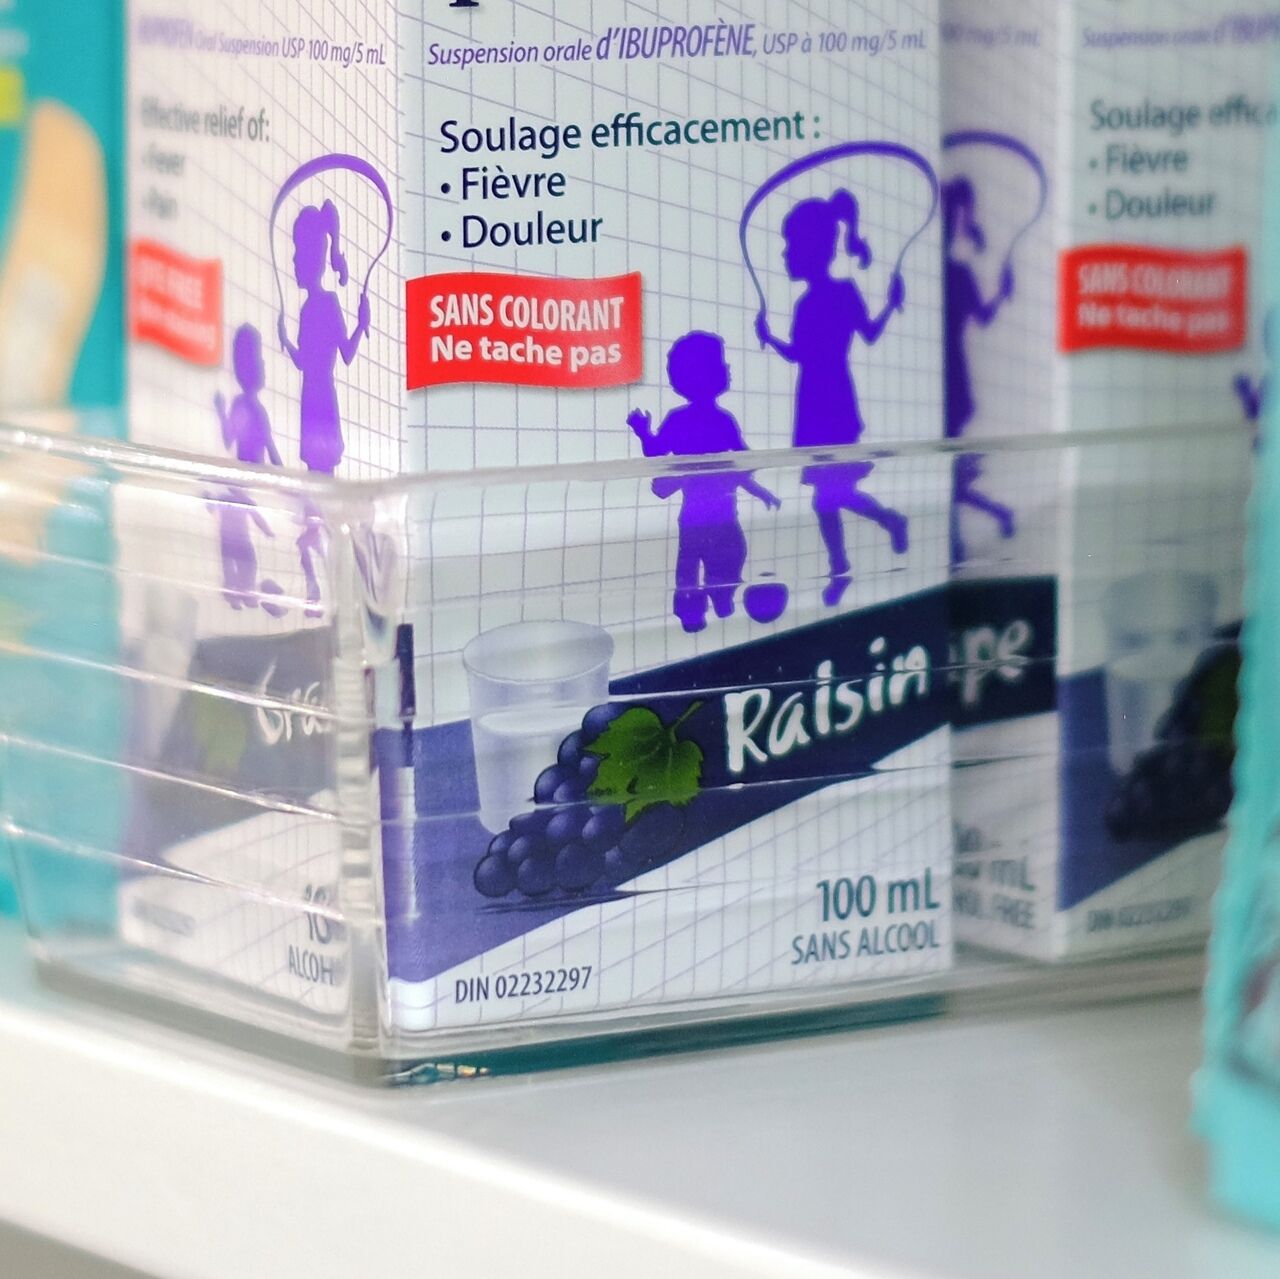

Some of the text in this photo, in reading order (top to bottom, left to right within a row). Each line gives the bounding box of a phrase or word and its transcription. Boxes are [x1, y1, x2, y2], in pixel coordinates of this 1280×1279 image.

[219, 33, 279, 58] Suspension
[281, 36, 306, 59] USP
[308, 39, 329, 61] 100
[330, 41, 364, 69] mg/5
[366, 43, 387, 66] mL
[428, 17, 927, 70] Suspension orale d'IBUPROFÈNE, USP à 100 mg/5 mL
[204, 103, 245, 139] relief
[247, 106, 270, 143] of:
[440, 116, 581, 160] Soulage
[591, 111, 805, 150] efficacement
[1090, 98, 1201, 136] Soulage
[1106, 143, 1189, 174] Fièvre
[461, 165, 567, 200] Fièvre
[1105, 188, 1216, 220] Douleur
[461, 210, 604, 248] Douleur
[430, 293, 624, 331] SANS COLORANT
[431, 333, 622, 372] Ne tache pas
[723, 635, 927, 772] Raisin
[817, 873, 877, 922] 100
[887, 867, 940, 914] mL
[791, 919, 941, 966] SANS ALCOOL
[454, 965, 593, 1004] DIN 02232297
